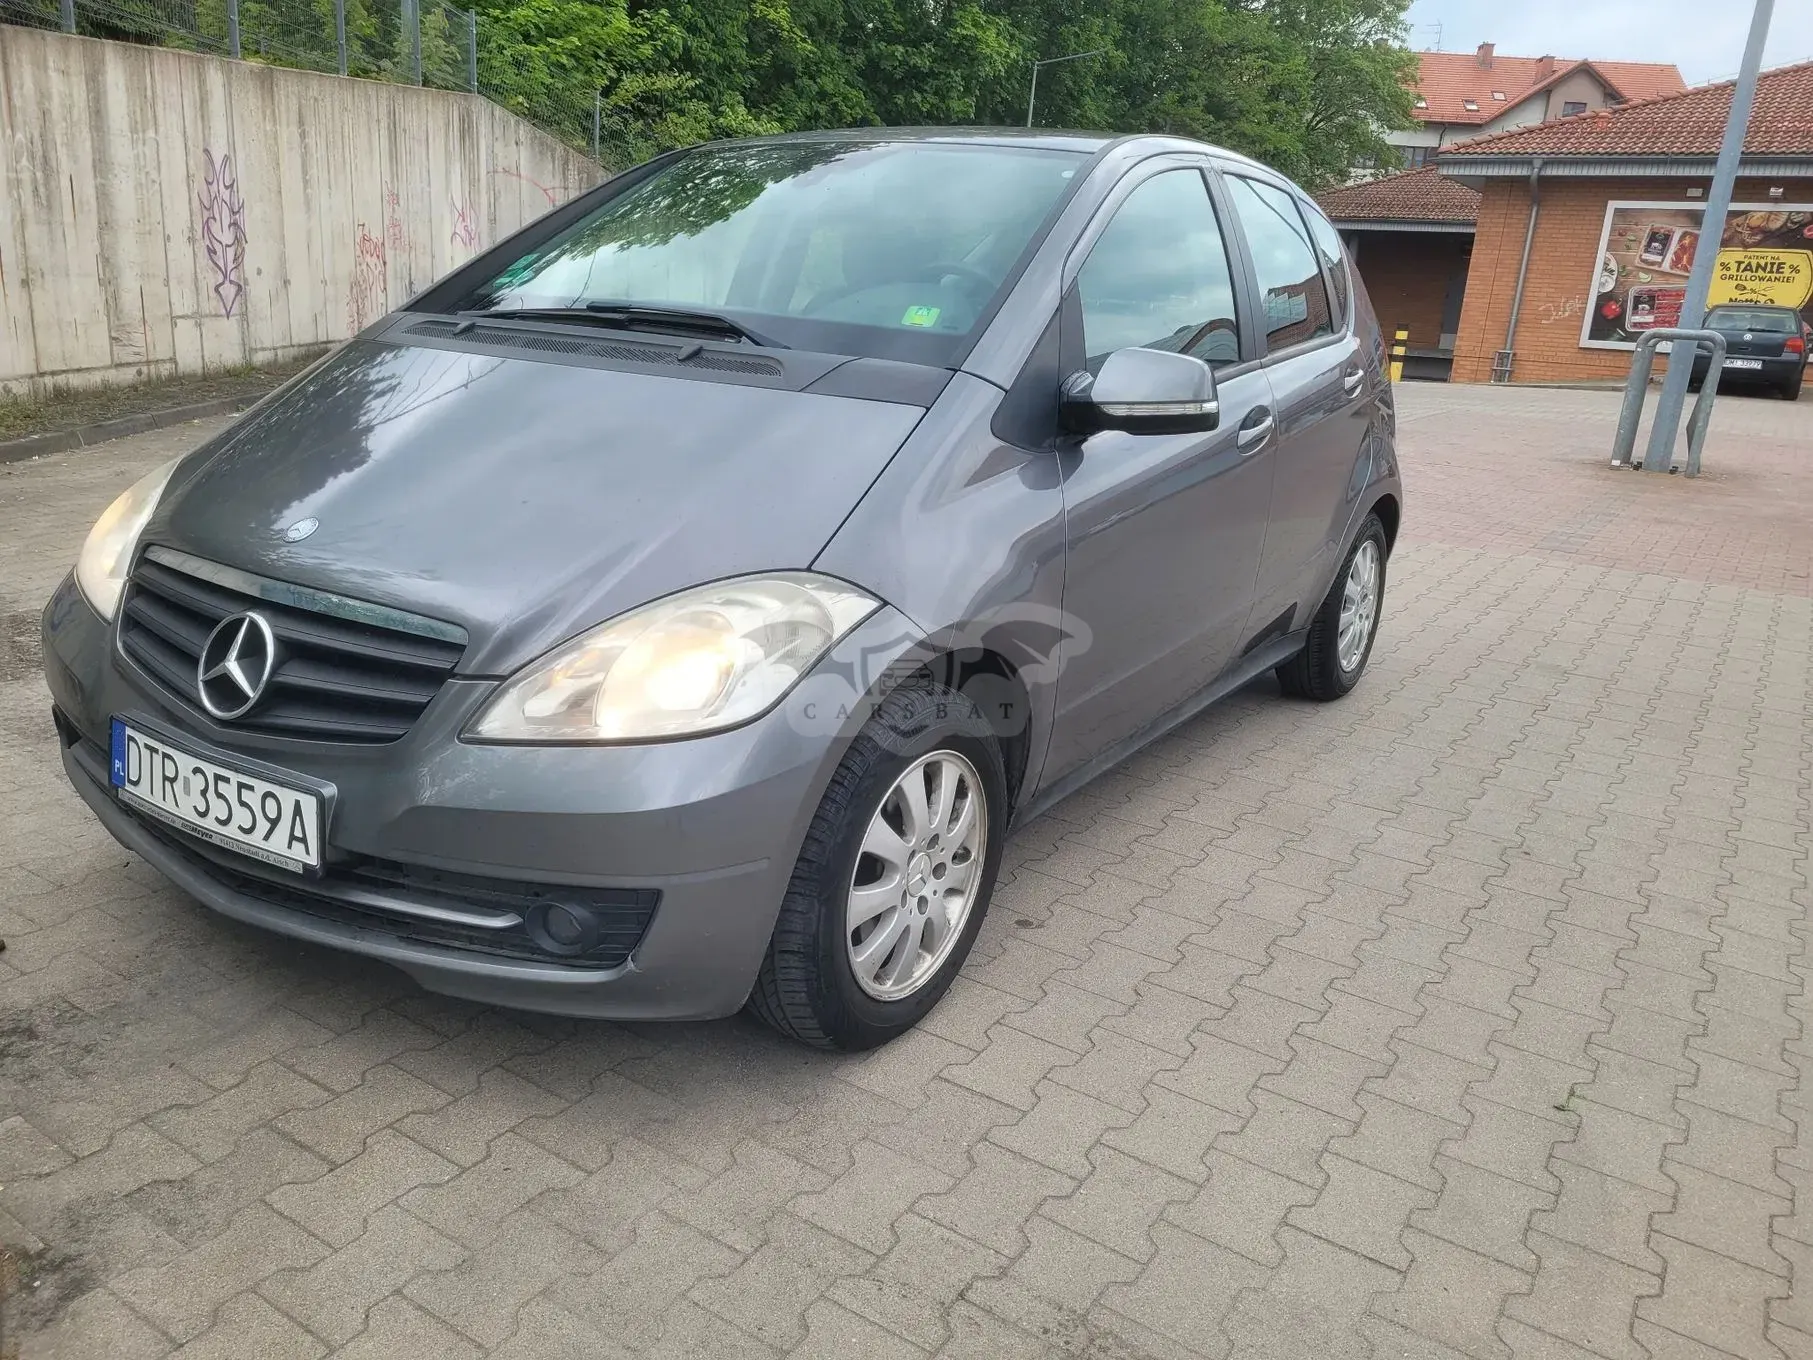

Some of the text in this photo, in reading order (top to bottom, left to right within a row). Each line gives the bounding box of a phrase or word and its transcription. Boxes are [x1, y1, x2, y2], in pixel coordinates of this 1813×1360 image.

[1735, 261, 1786, 274] TANIE
[1720, 274, 1795, 283] GRILLOWANIE!
[115, 759, 124, 776] PL
[127, 734, 311, 856] DTR 3559A
